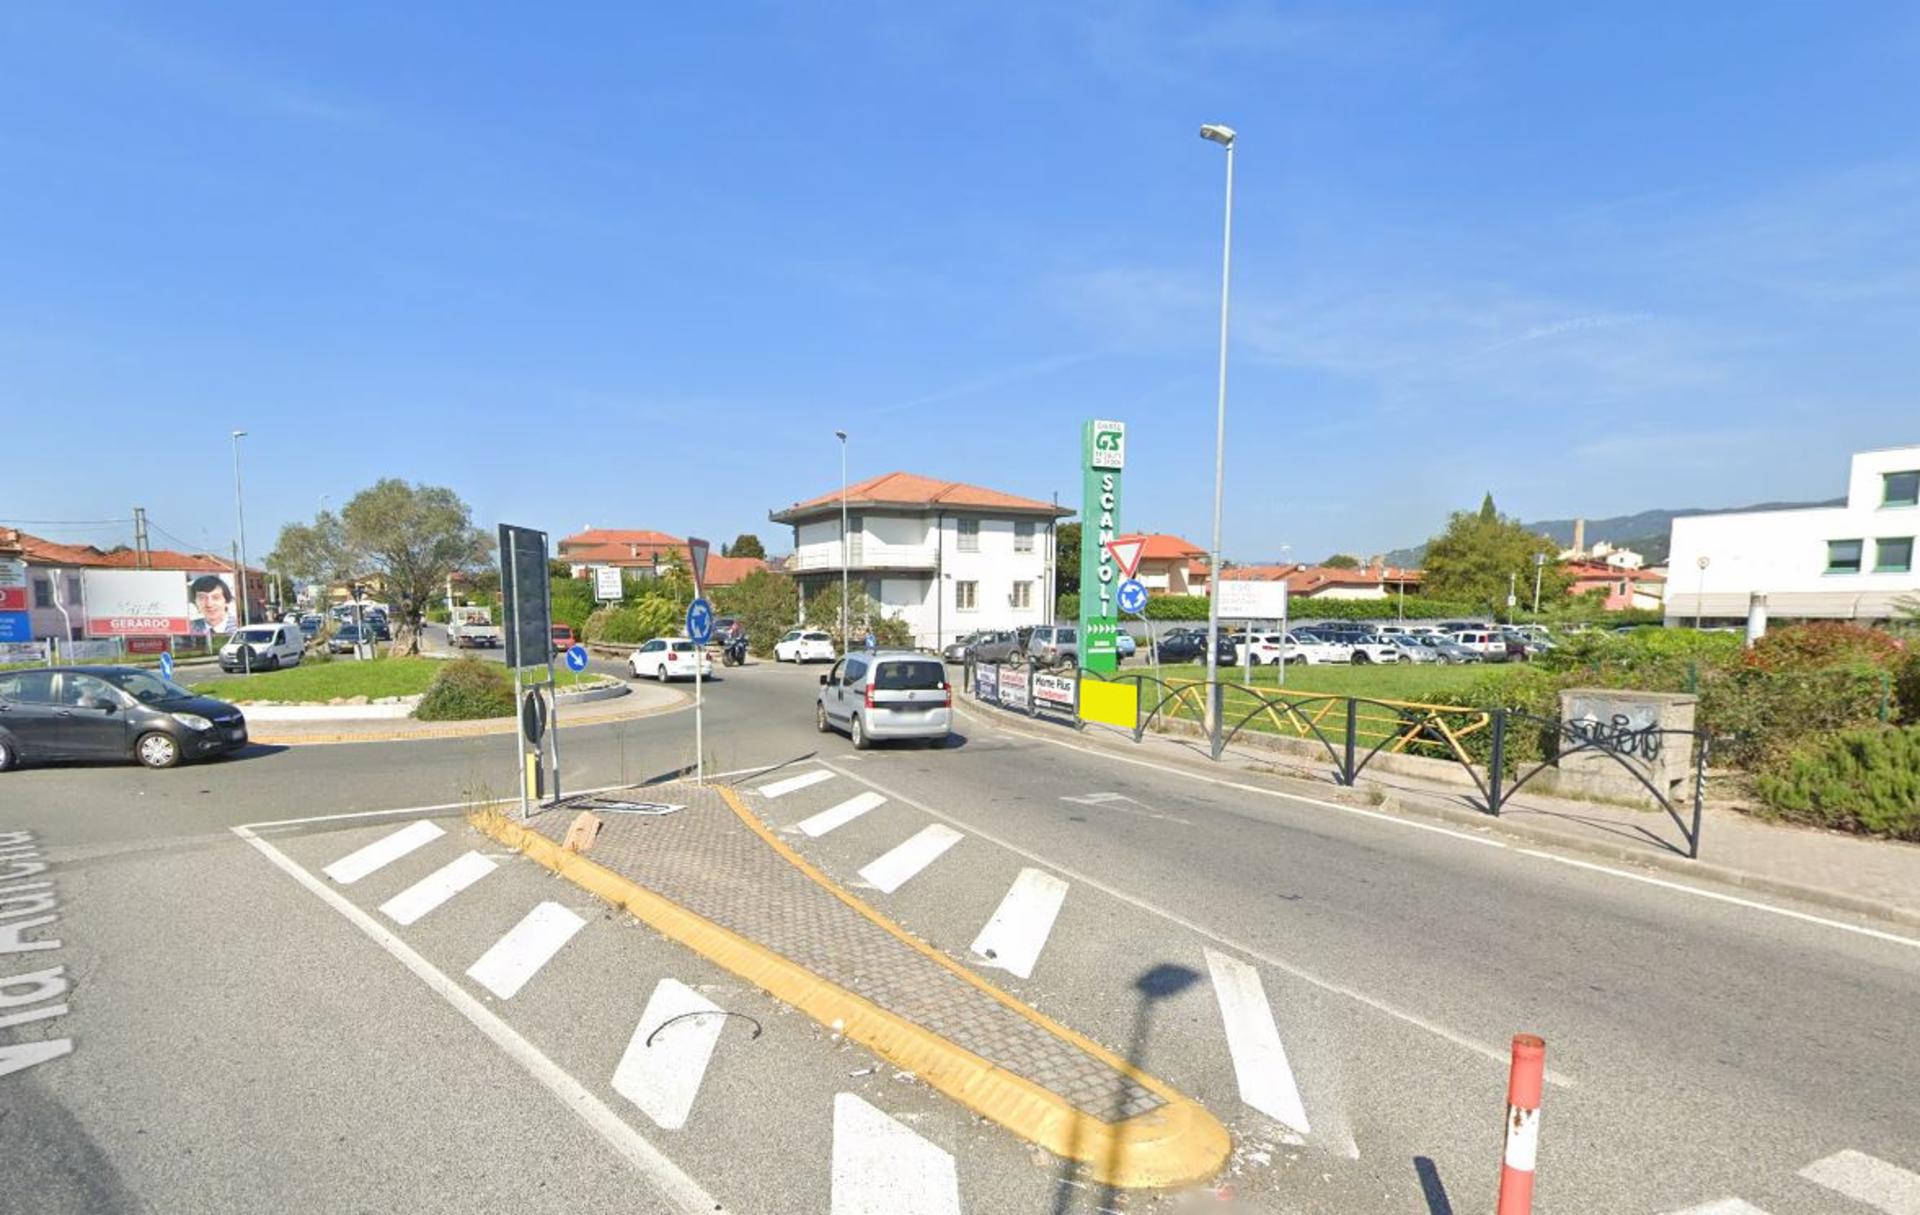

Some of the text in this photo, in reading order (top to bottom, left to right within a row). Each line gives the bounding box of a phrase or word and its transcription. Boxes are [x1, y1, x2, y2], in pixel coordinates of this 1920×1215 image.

[1096, 431, 1123, 451] GS
[1097, 473, 1114, 617] SCAMPOLI
[110, 618, 170, 630] GERARDO
[1035, 676, 1055, 689] Home
